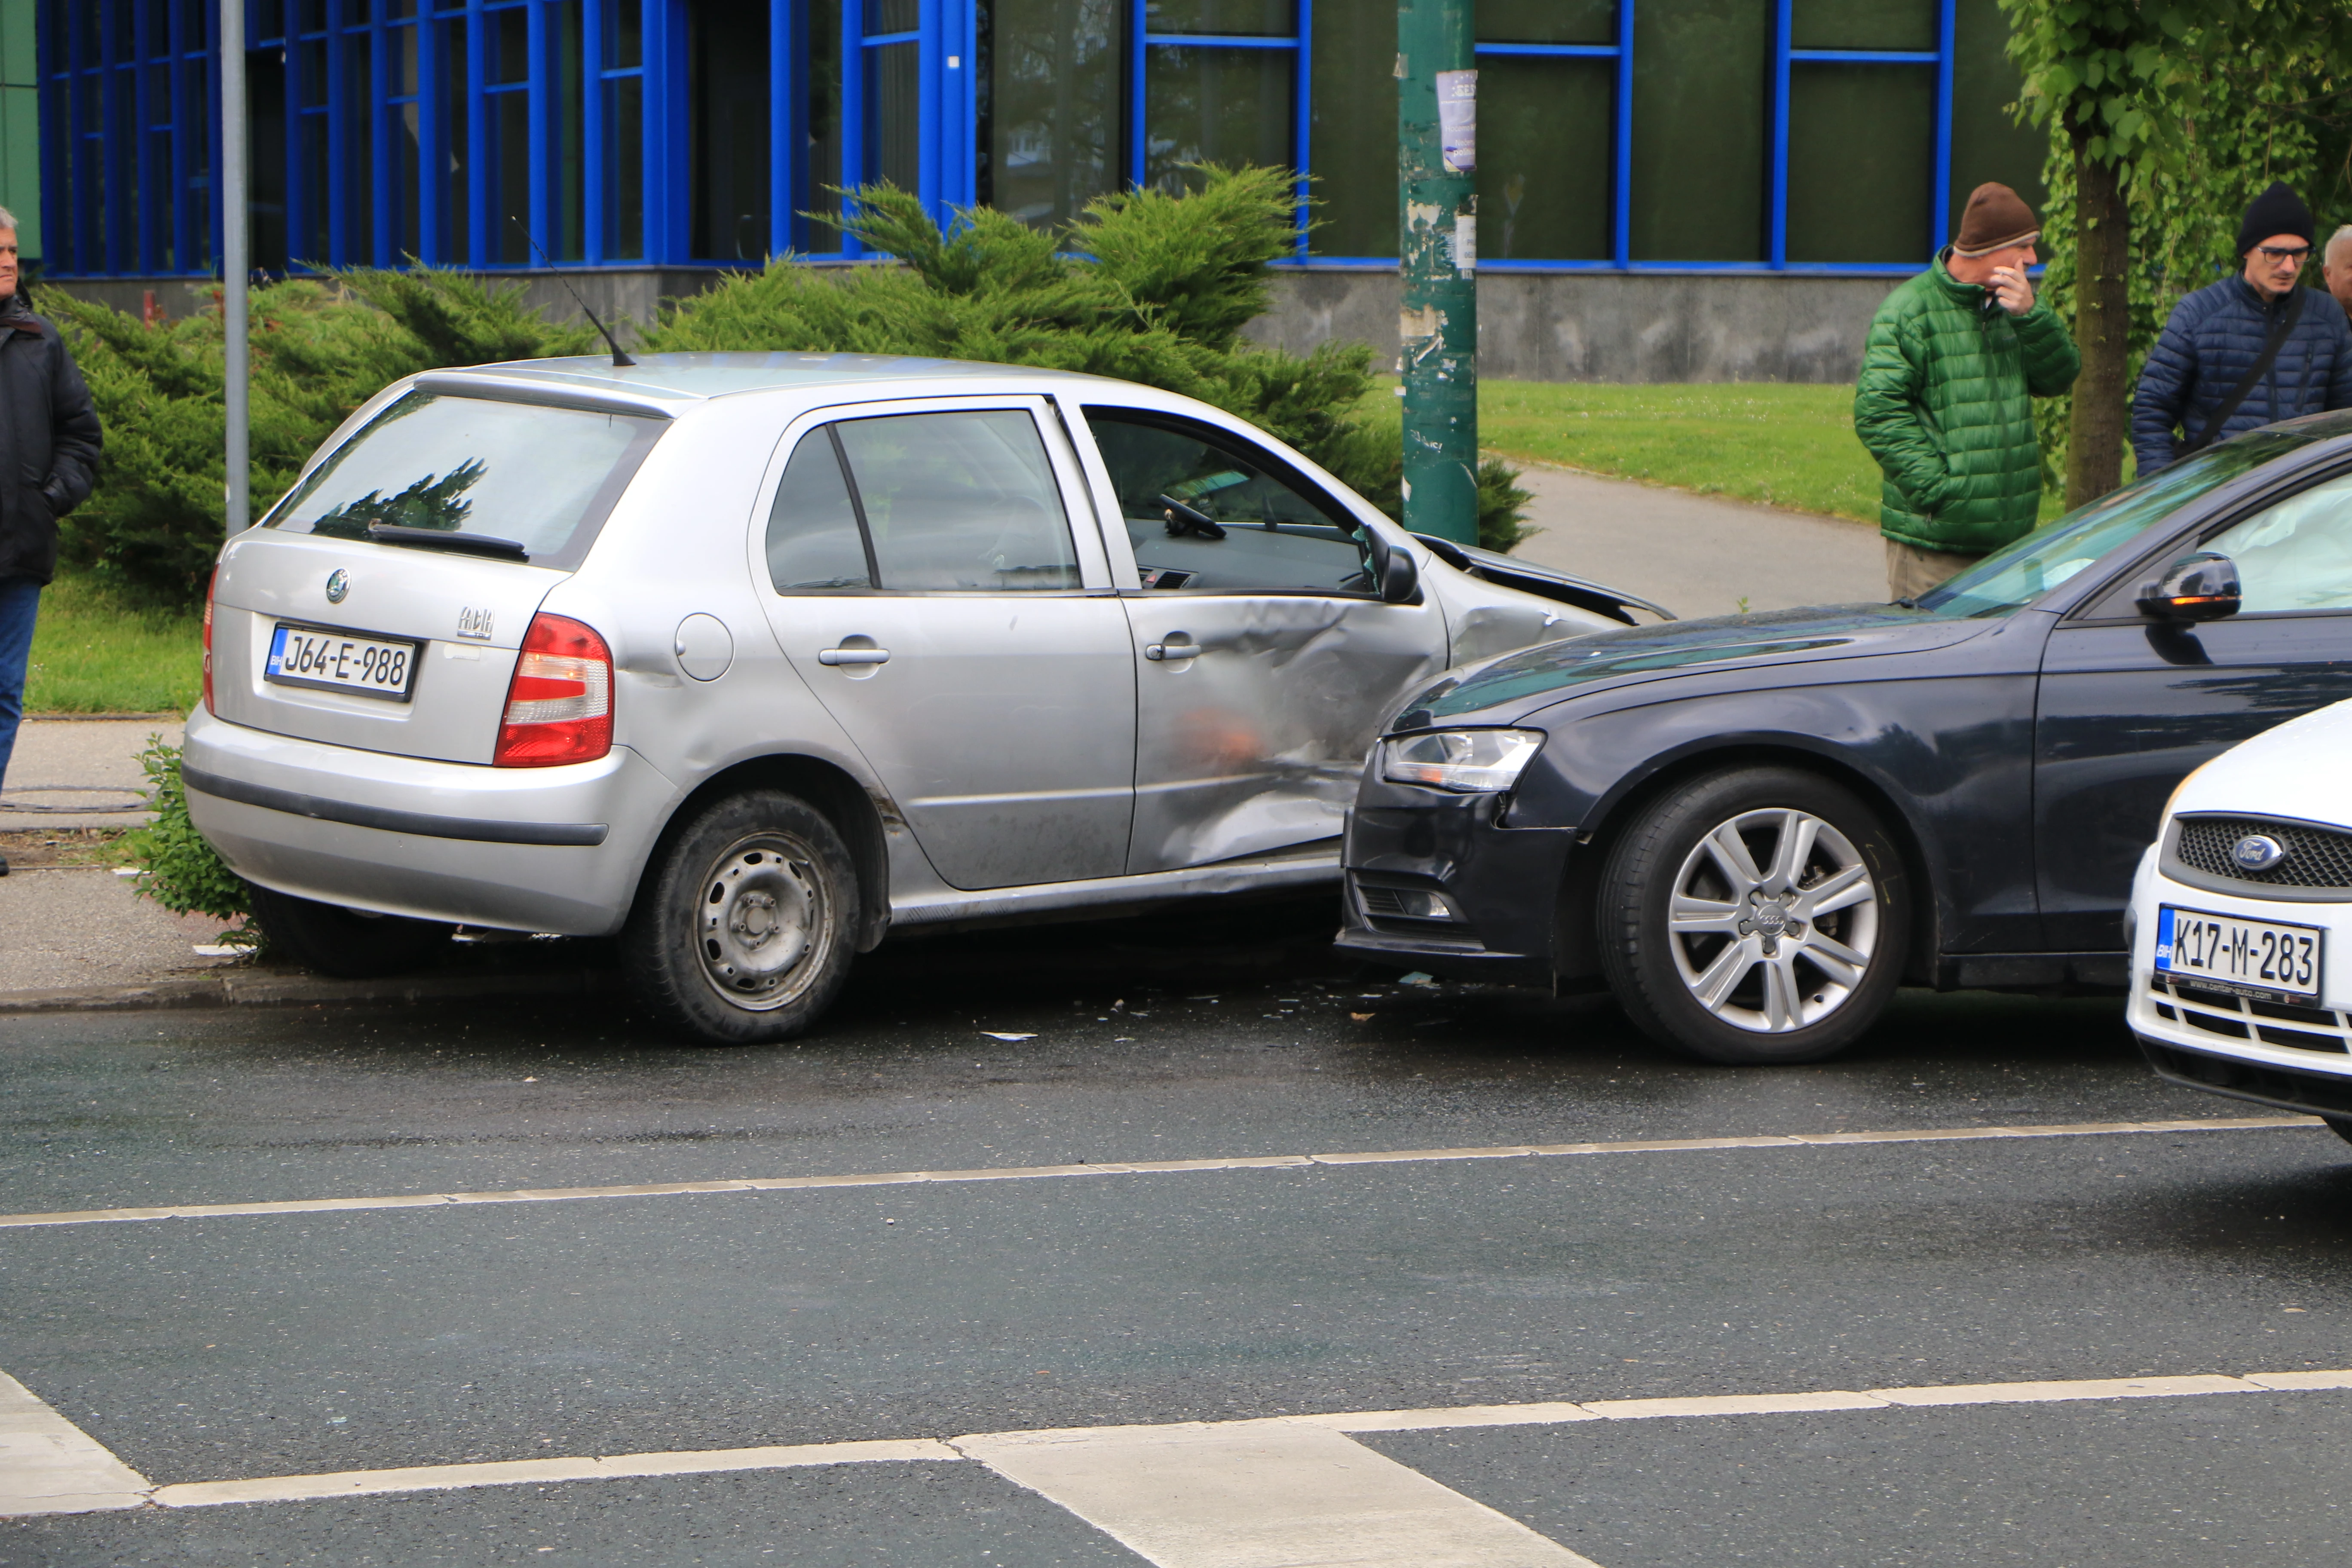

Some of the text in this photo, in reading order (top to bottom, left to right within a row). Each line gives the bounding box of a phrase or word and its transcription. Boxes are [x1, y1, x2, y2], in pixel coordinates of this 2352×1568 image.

[458, 606, 495, 632] FABIA
[285, 636, 406, 686] J64-E-988
[2240, 840, 2266, 861] Ford
[2175, 917, 2314, 986] K17-M-283
